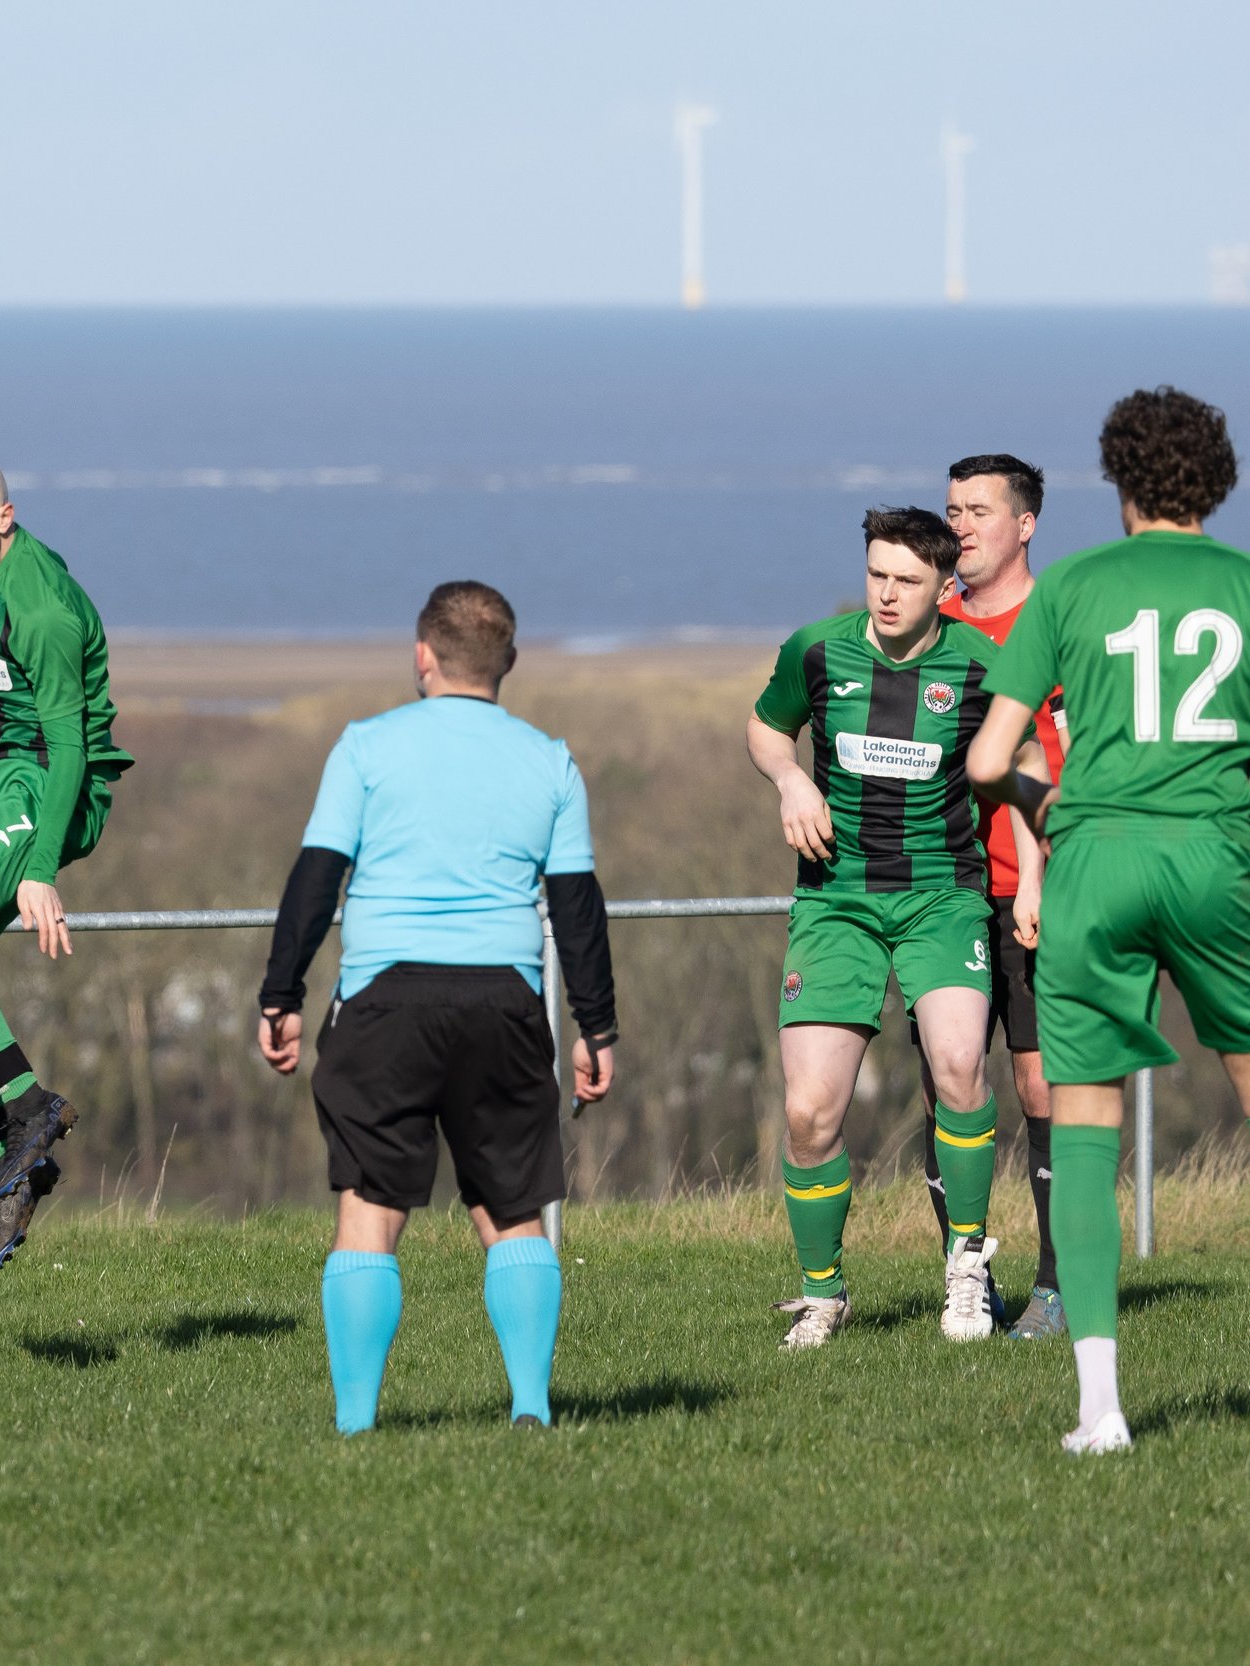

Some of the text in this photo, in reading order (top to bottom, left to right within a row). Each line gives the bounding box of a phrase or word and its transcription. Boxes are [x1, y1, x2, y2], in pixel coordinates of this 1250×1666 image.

[1105, 608, 1243, 742] 12
[863, 739, 926, 757] Lakeland
[863, 752, 937, 768] Verandahs
[6, 814, 33, 832] 7
